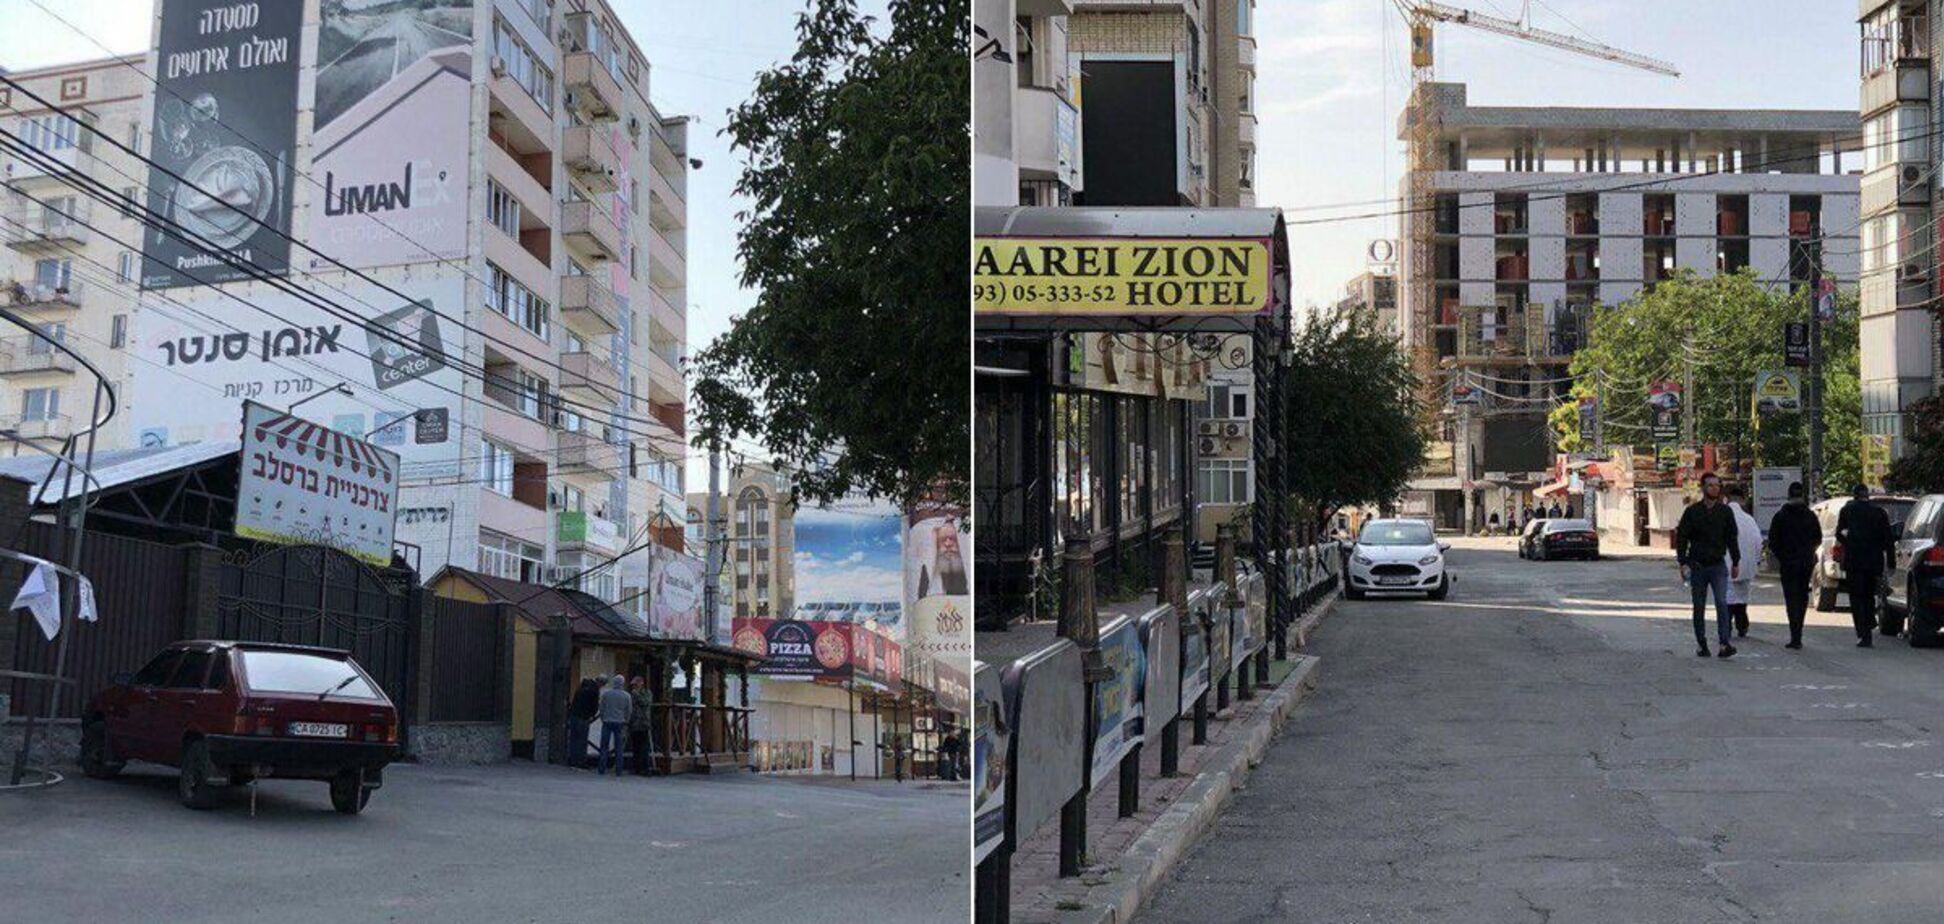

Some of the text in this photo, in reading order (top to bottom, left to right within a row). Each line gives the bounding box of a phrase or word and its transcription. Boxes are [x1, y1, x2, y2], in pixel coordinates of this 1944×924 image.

[200, 2, 259, 35] מסעדה
[167, 34, 288, 79] ואולם אירועים
[974, 245, 1254, 278] AAREI ZION
[1013, 285, 1117, 302] 05-333-52
[1125, 281, 1256, 306] HOTEL
[157, 324, 342, 366] אומן סנטר
[382, 356, 431, 383] center
[223, 378, 313, 398] מרכז קניות
[252, 451, 320, 494] ברסלב
[769, 642, 813, 655] PIZZA
